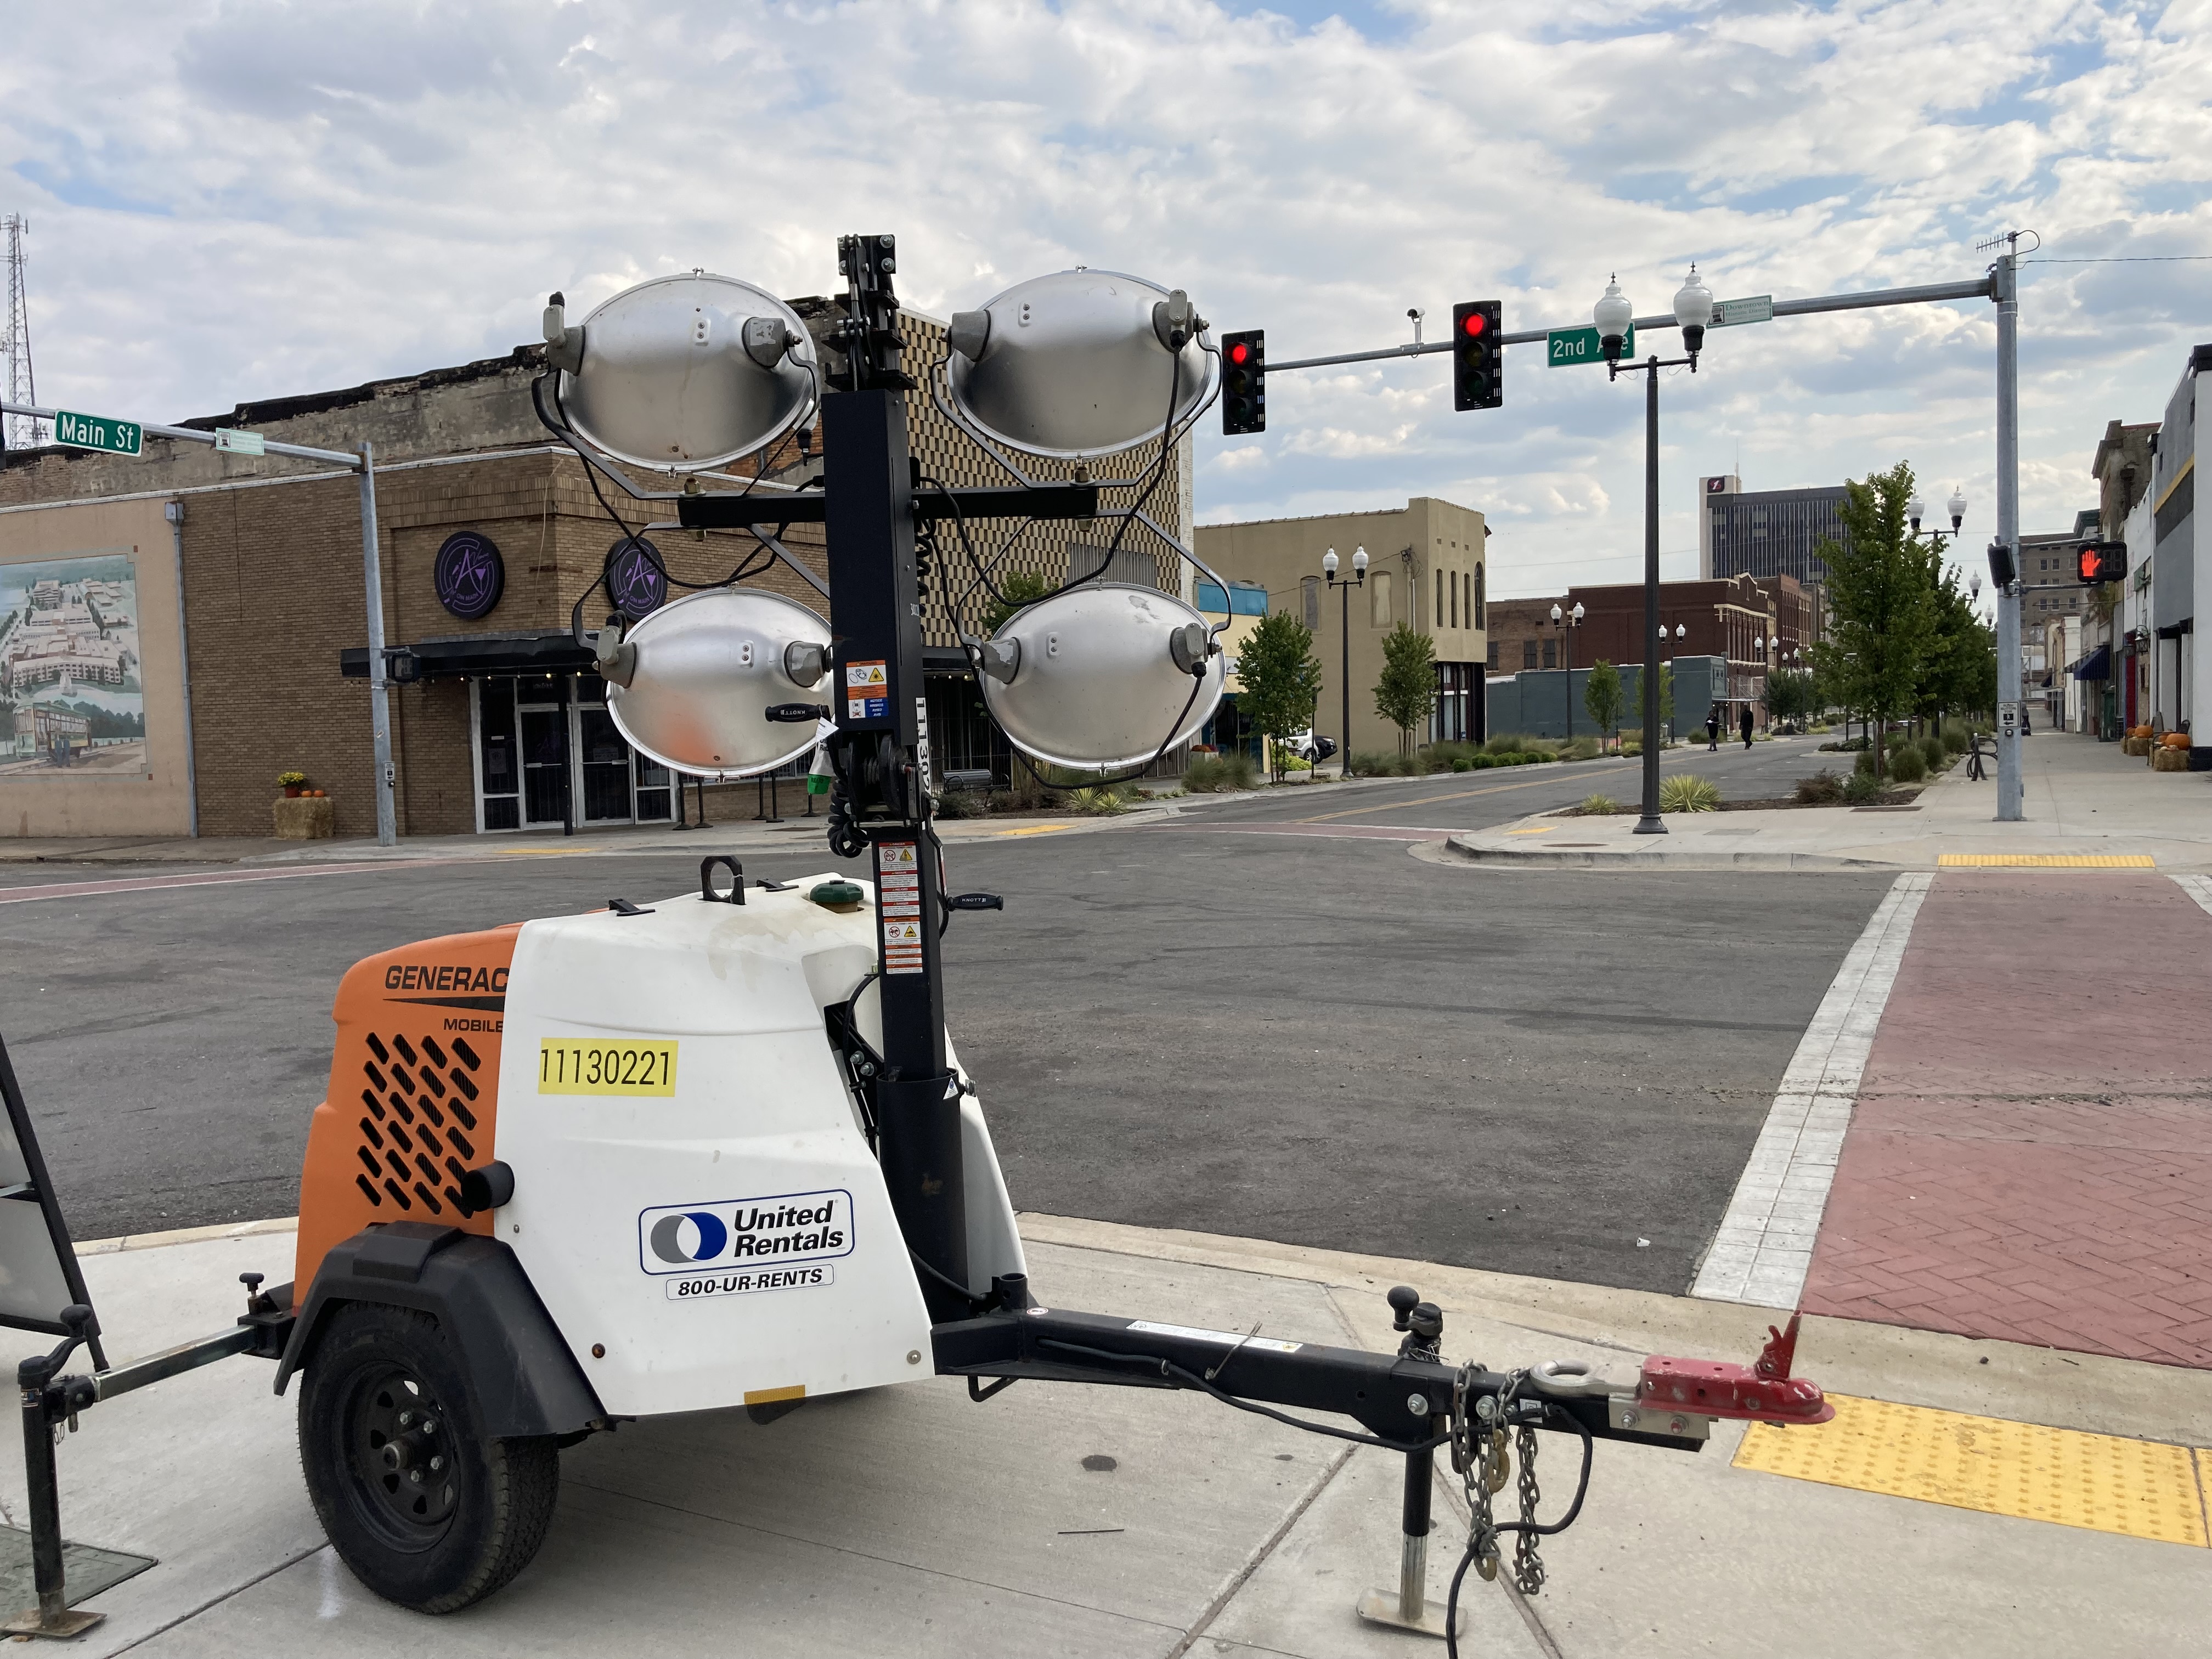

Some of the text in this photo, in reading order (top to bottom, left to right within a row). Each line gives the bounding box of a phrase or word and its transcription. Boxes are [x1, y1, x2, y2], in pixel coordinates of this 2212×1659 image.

[1725, 301, 1769, 311] Downtown
[1553, 336, 1629, 358] 2nd Ae
[61, 415, 133, 450] Main St
[385, 965, 510, 992] GENERAC
[443, 1018, 503, 1032] MOBILE
[540, 1048, 669, 1085] 11130221
[734, 1200, 833, 1231] United
[734, 1226, 843, 1257] Rentals
[678, 1268, 822, 1296] 800-UR-RENTS
